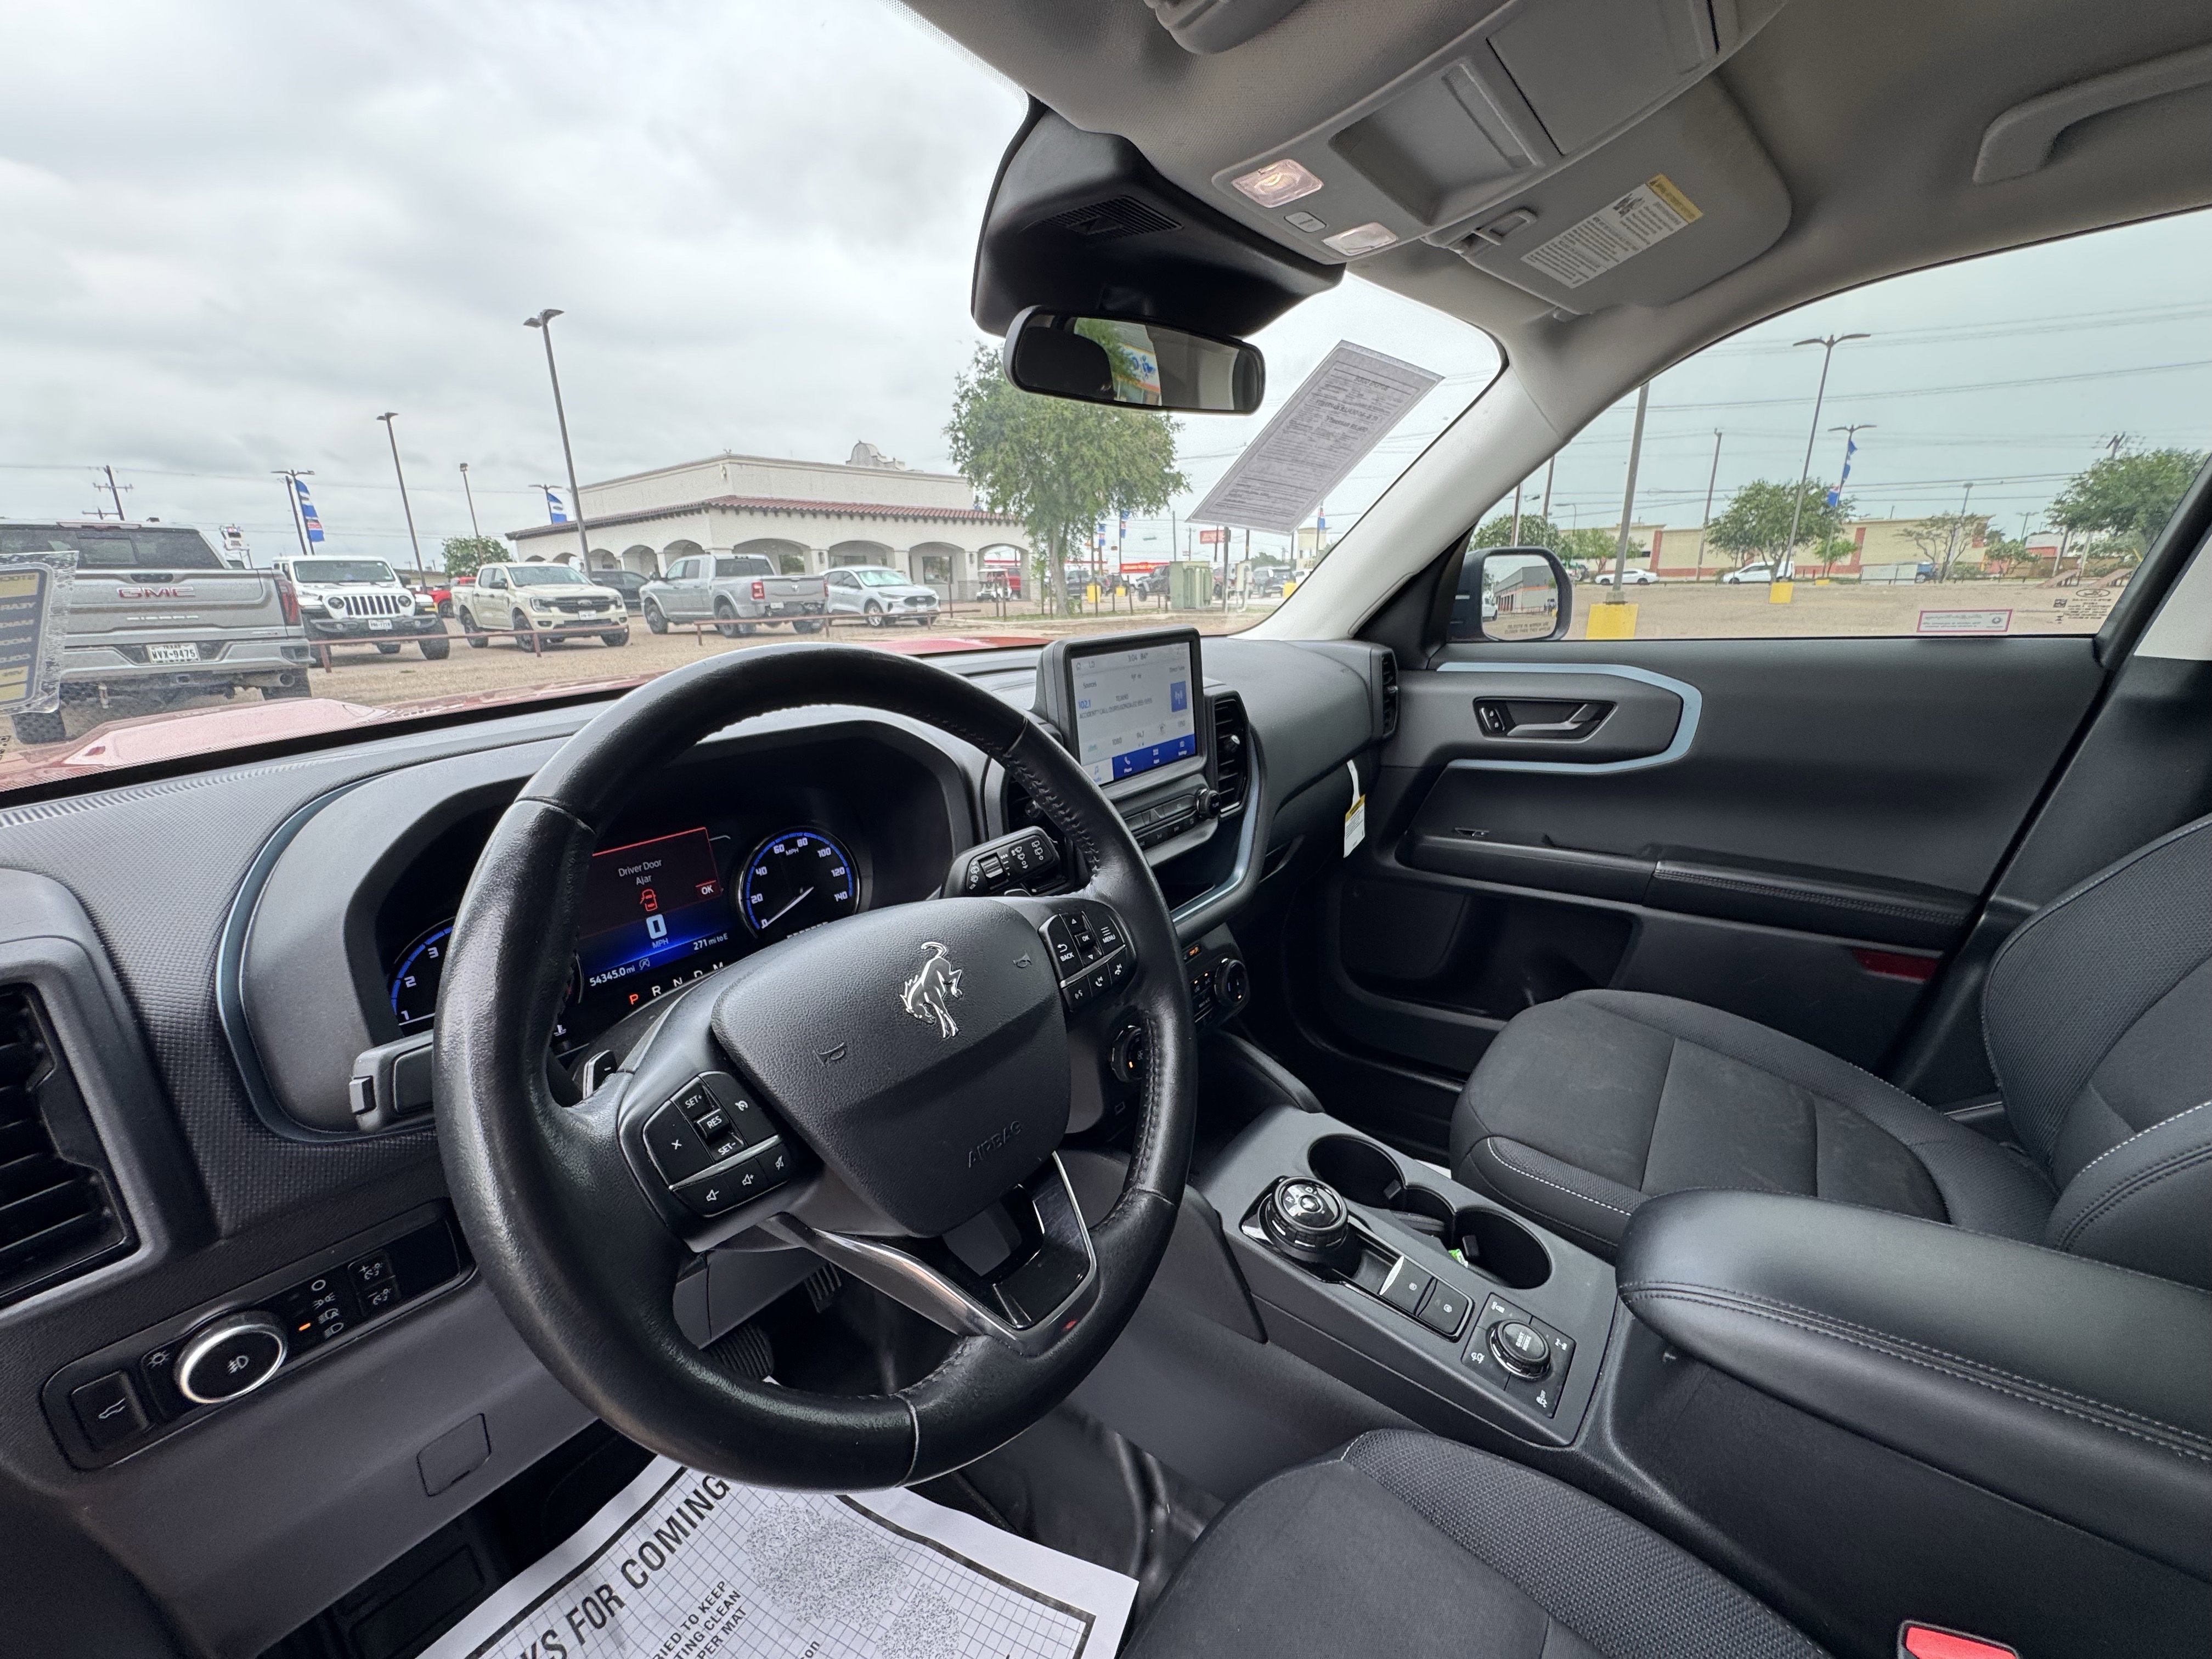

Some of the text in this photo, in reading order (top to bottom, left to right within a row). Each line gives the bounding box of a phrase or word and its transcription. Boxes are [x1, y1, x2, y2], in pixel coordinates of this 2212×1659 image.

[117, 586, 196, 599] GMC
[773, 844, 785, 854] 60
[797, 837, 809, 848] 80
[785, 848, 799, 856] MPH
[817, 847, 832, 858] 100
[618, 859, 662, 877] Driver Door
[755, 866, 768, 877] 40
[831, 867, 845, 878] 120
[636, 874, 652, 885] Ajar
[701, 885, 714, 895] OK
[834, 891, 848, 902] 140
[751, 893, 764, 905] 20
[646, 913, 668, 940] 0
[652, 937, 669, 949] MPH
[693, 939, 708, 951] 271
[708, 935, 716, 946] mi
[716, 935, 723, 944] to
[1102, 934, 1116, 944] MENU
[427, 946, 439, 959] 3
[1060, 952, 1075, 962] BACK
[404, 975, 417, 988] 2
[589, 965, 635, 987] 54345.0 mi
[629, 994, 639, 1005] P
[652, 985, 662, 997] R
[673, 977, 683, 987] N
[400, 1010, 409, 1020] 1
[685, 1094, 703, 1109] SET+
[706, 1115, 723, 1129] RES
[718, 1142, 736, 1156] SET-
[967, 1120, 1023, 1169] AIRBAG
[566, 1584, 626, 1646] FOR
[620, 1475, 731, 1589] COMING
[680, 1613, 699, 1631] TO
[698, 1580, 726, 1614] KEEP
[703, 1590, 741, 1631] CLEAN
[720, 1606, 747, 1635] MAT
